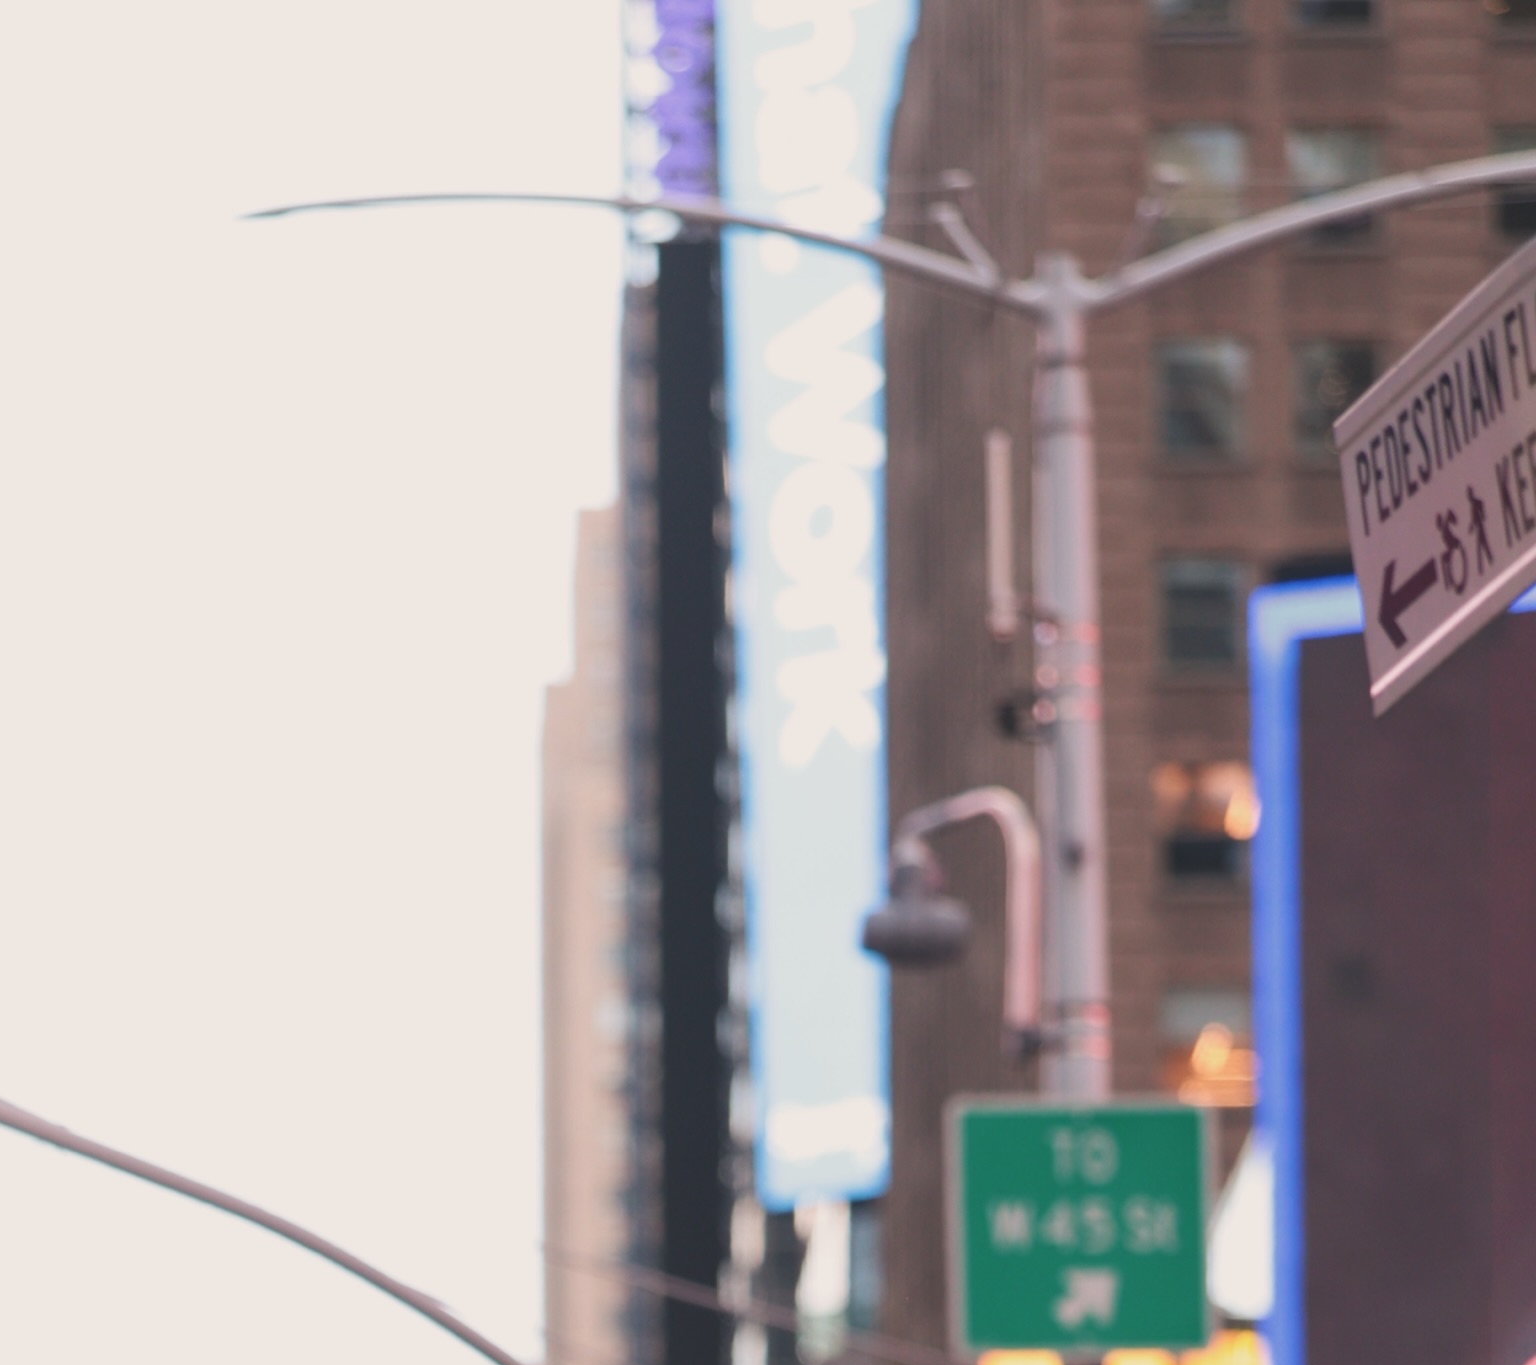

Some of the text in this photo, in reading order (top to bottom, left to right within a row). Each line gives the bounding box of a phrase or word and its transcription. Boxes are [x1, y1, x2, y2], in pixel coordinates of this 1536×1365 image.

[1355, 300, 1536, 538] PEDESTRIAN FL
[1048, 1127, 1119, 1184] TO
[987, 1199, 1033, 1252] W
[1042, 1197, 1116, 1253] 45
